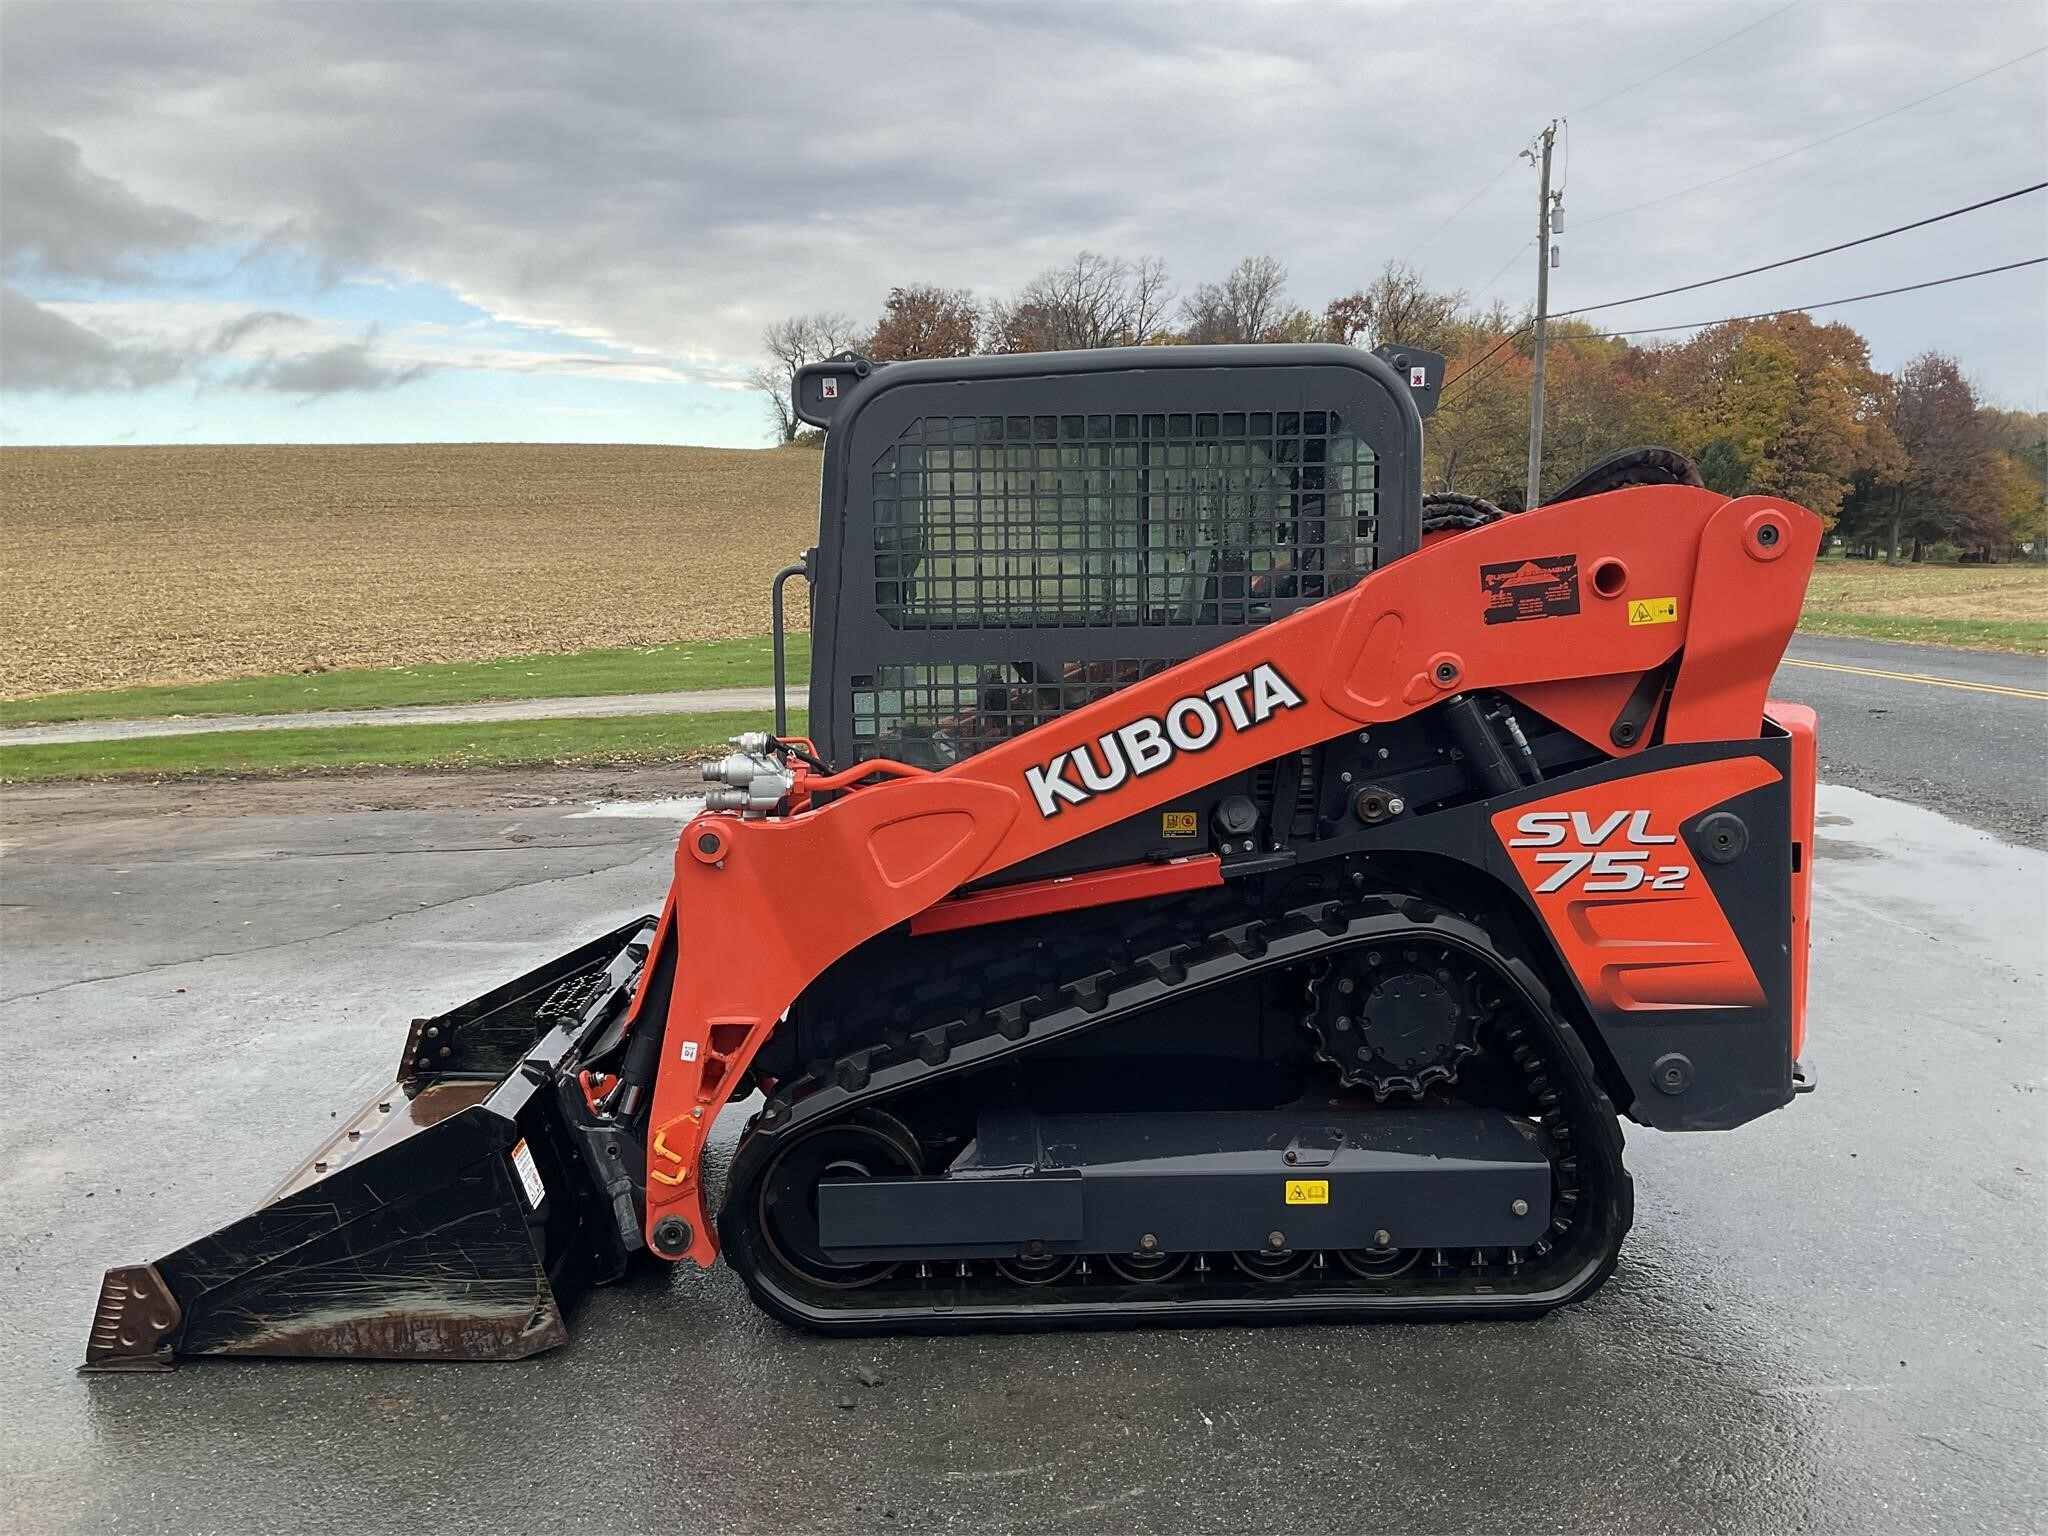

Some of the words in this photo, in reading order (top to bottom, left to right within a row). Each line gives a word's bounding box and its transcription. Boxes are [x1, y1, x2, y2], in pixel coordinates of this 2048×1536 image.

[1024, 663, 1302, 818] KUBOTA
[1508, 810, 1677, 847] SVL
[1534, 851, 1690, 893] 75-2
